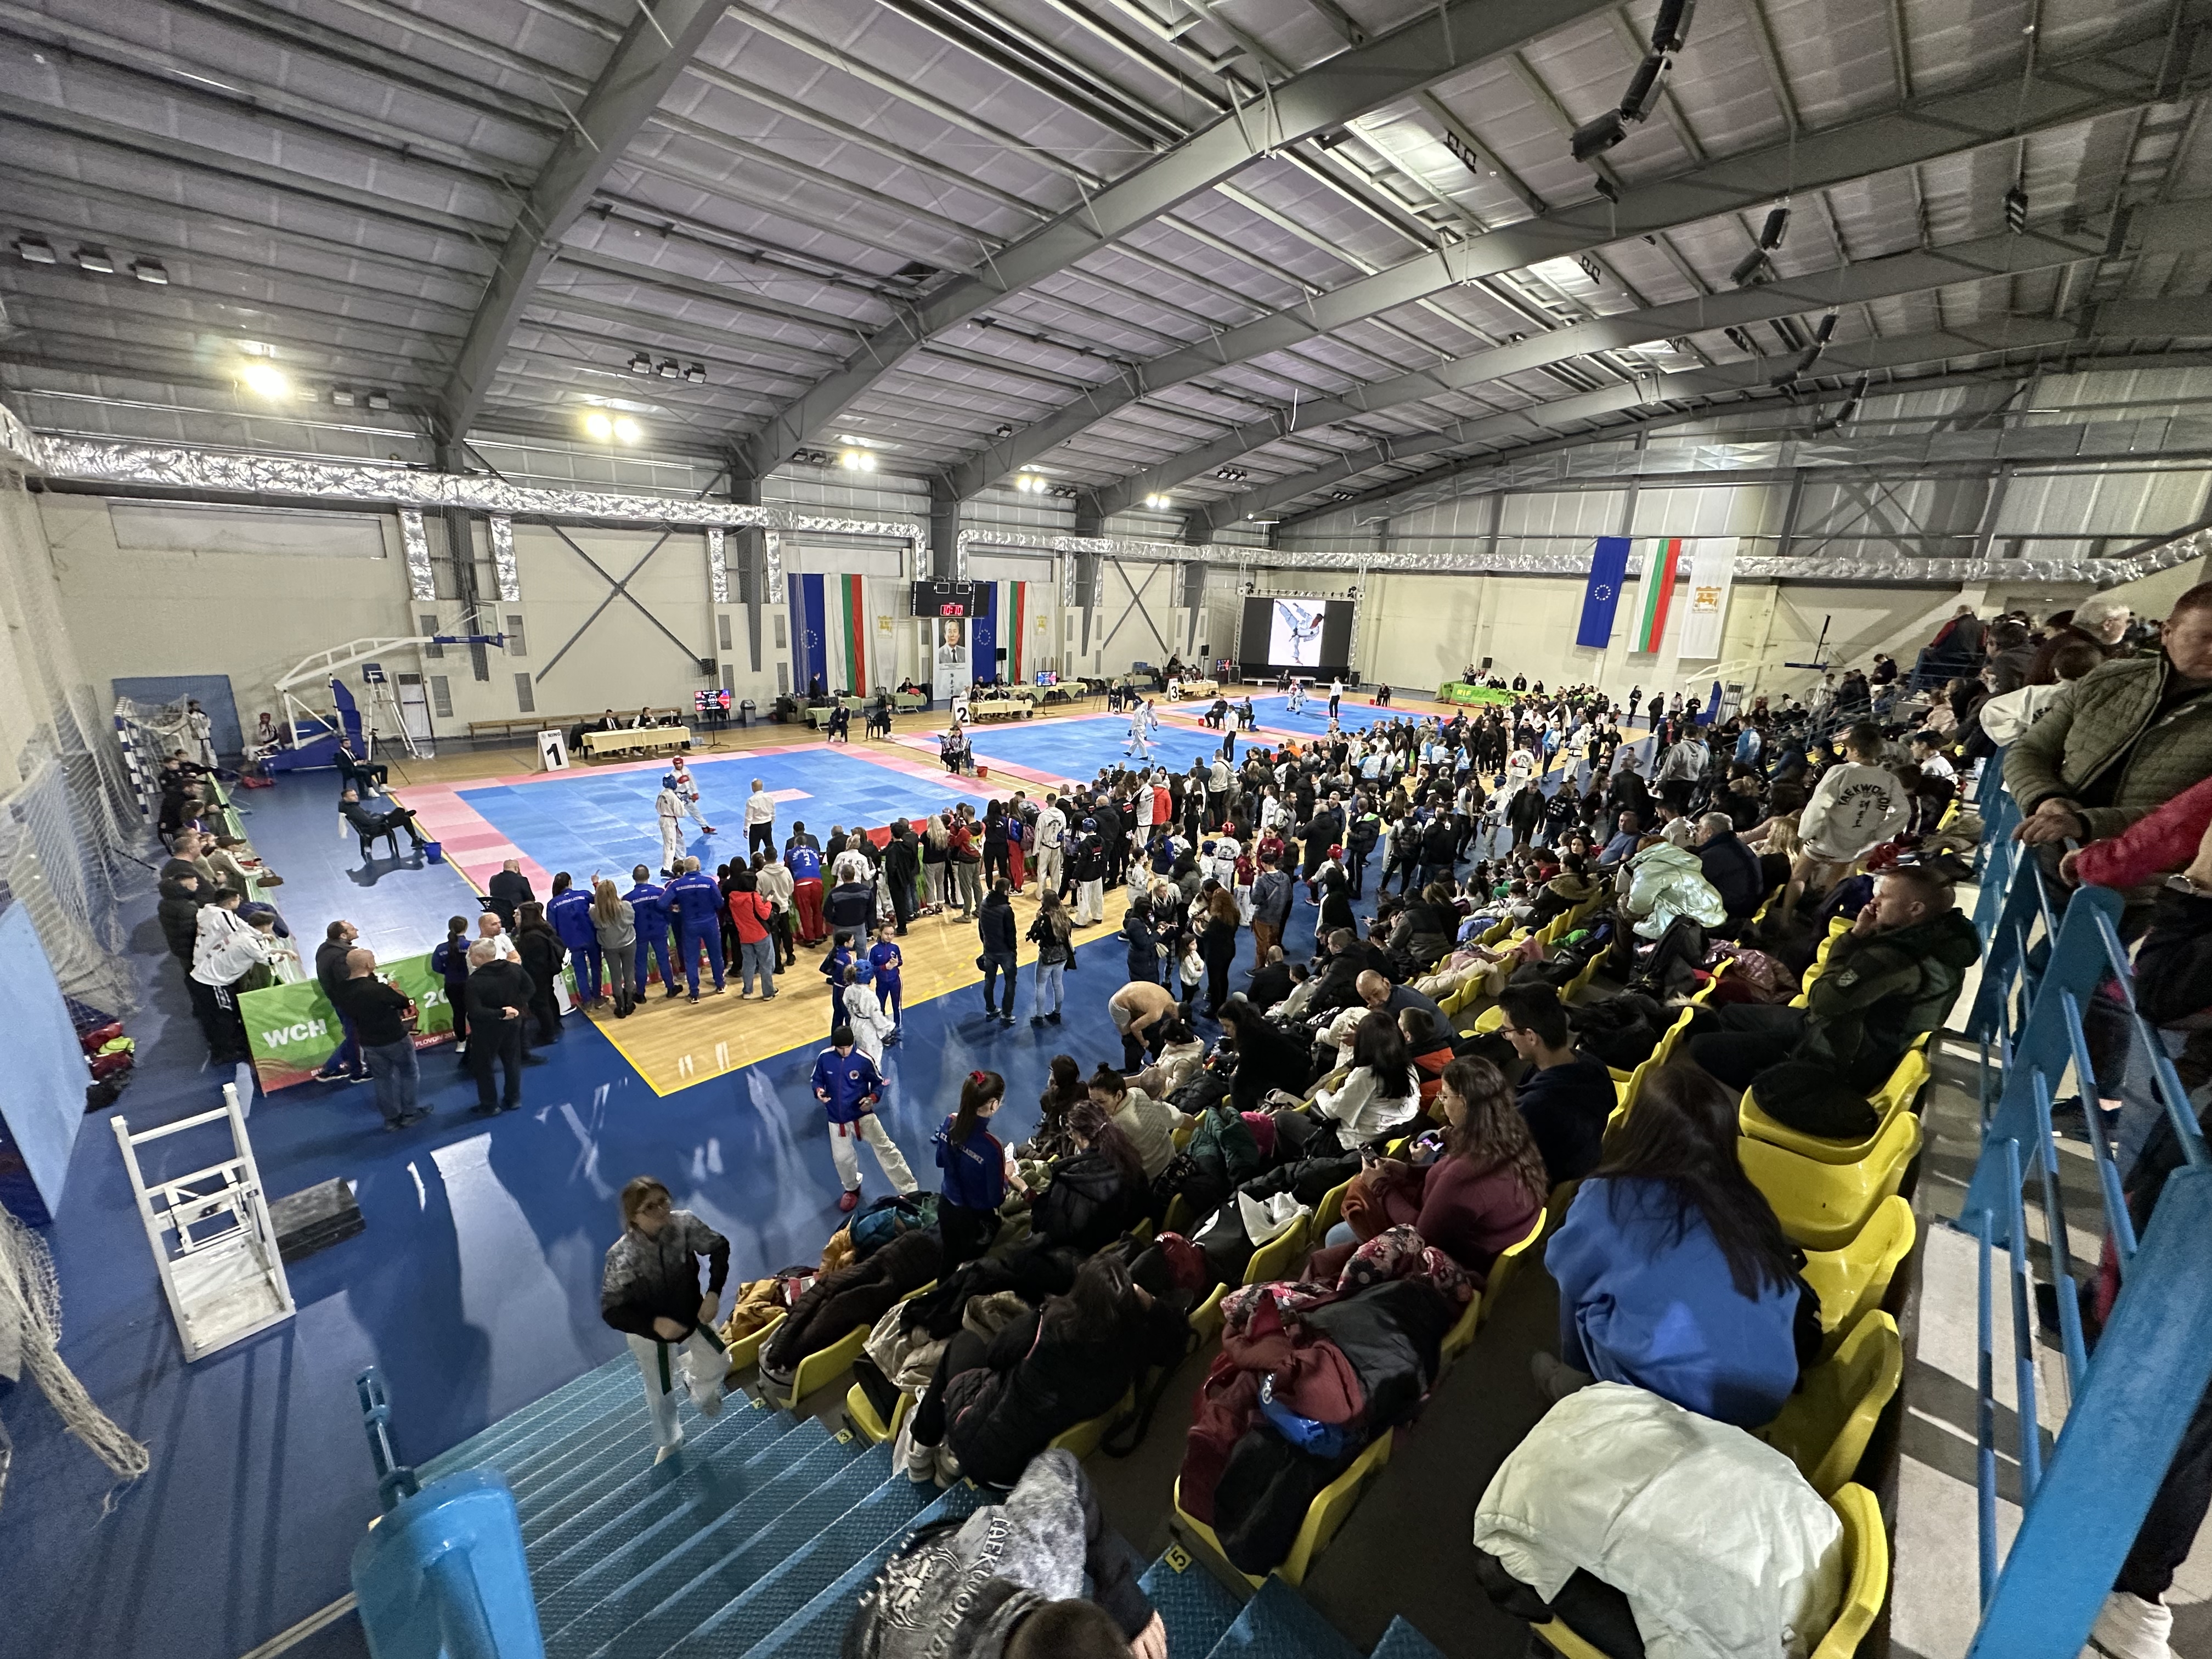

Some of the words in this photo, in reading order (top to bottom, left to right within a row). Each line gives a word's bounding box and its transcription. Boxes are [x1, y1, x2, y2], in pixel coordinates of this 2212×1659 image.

[943, 606, 962, 615] 10:10
[1171, 686, 1178, 698] 3
[957, 707, 968, 723] 2
[546, 743, 562, 766] 1
[262, 1018, 328, 1048] WCH
[415, 1035, 443, 1047] PLOVDIV
[840, 1432, 849, 1441] 3
[1171, 1550, 1186, 1567] 5
